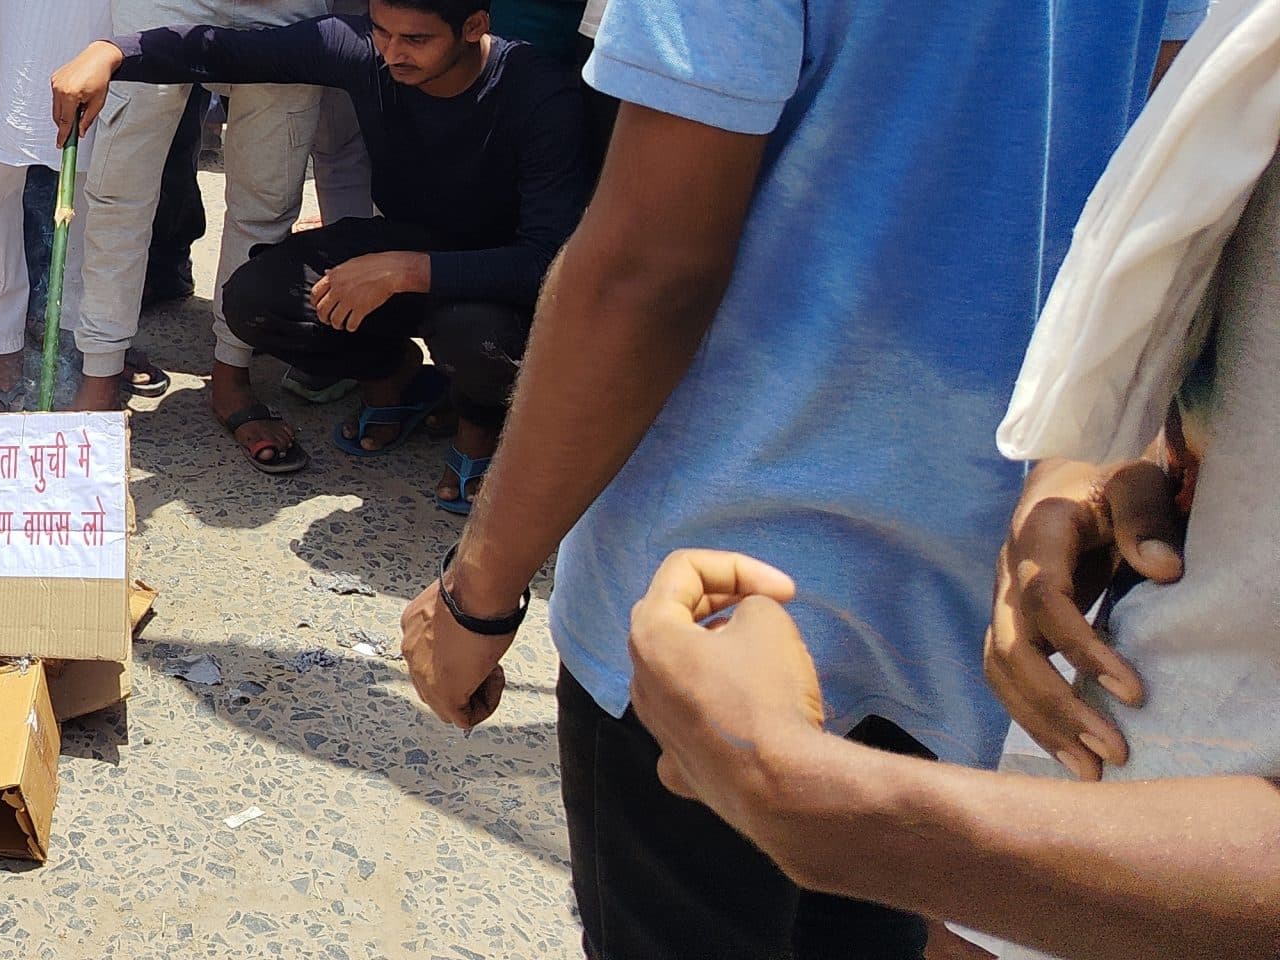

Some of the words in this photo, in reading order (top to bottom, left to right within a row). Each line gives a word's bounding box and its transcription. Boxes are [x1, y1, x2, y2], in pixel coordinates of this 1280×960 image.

[29, 431, 68, 493] सुची
[78, 430, 92, 478] मे
[23, 511, 72, 546] वापस
[81, 496, 106, 546] लो
